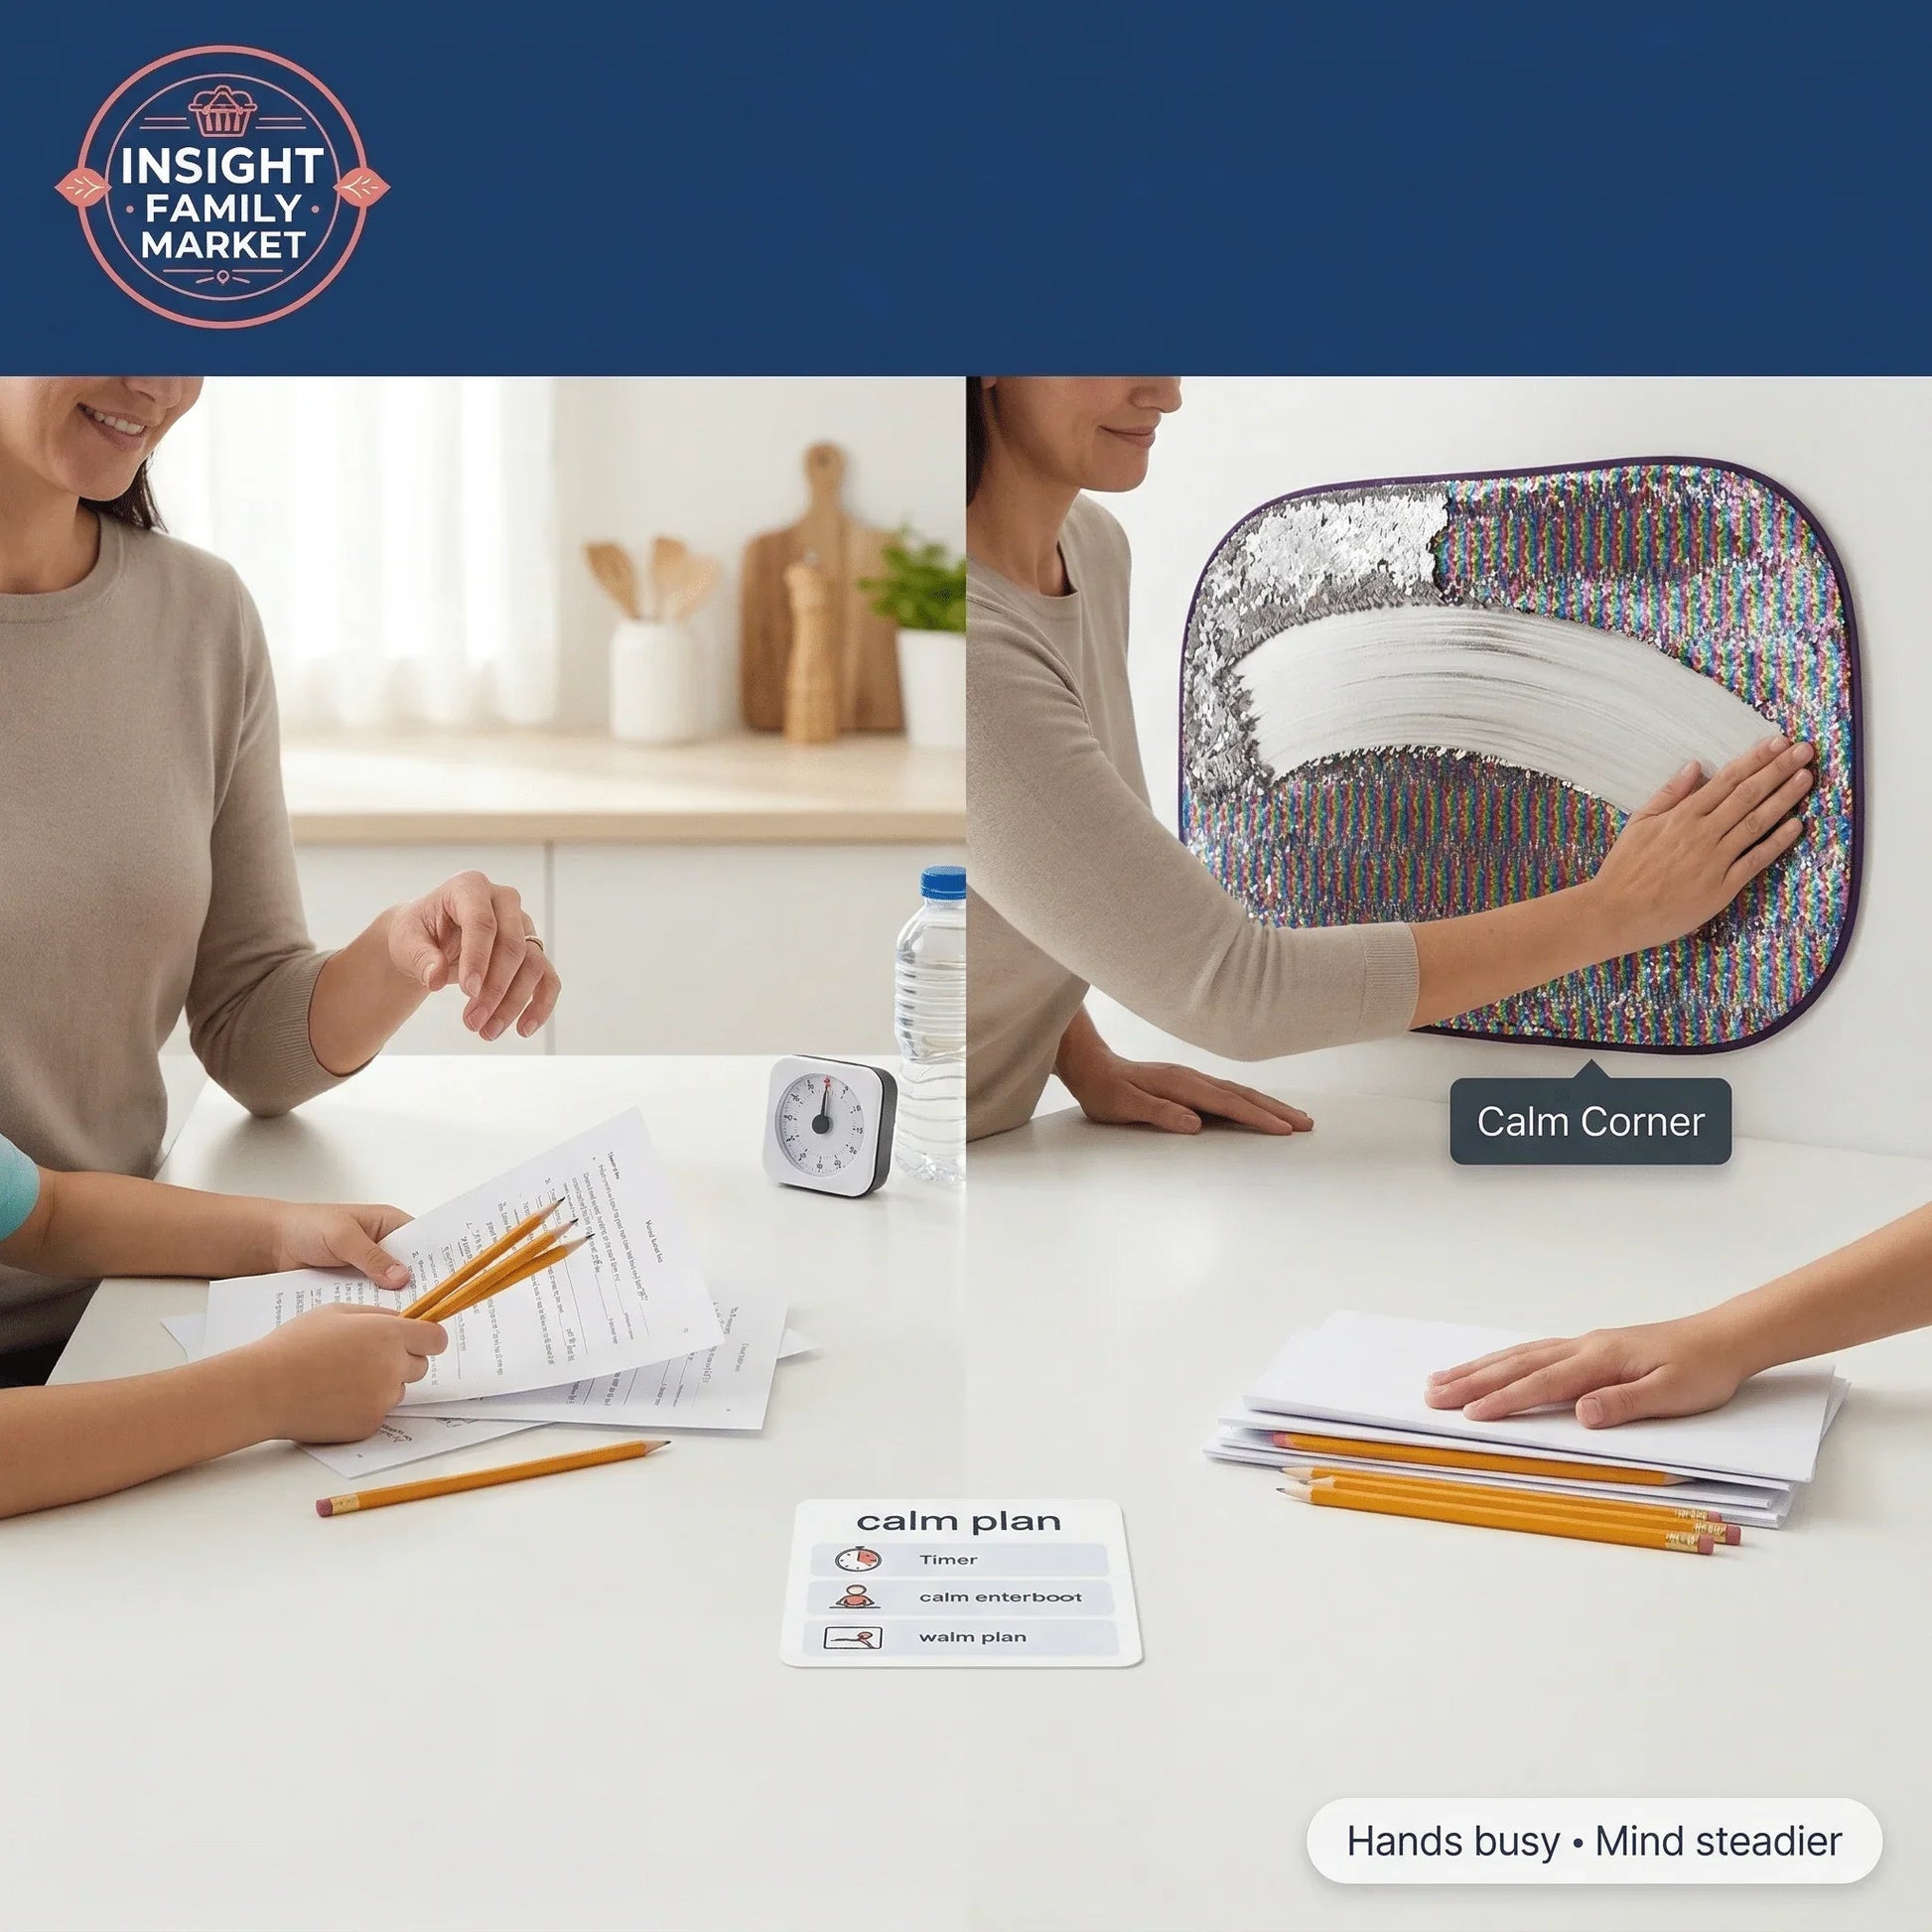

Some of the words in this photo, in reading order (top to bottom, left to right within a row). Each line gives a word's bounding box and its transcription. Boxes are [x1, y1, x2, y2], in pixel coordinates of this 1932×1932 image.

[857, 1510, 958, 1531] calm
[972, 1510, 1061, 1536] plan
[919, 1554, 978, 1566] Timer
[919, 1591, 969, 1603] calm
[918, 1631, 975, 1643] walm
[981, 1631, 1027, 1645] plan
